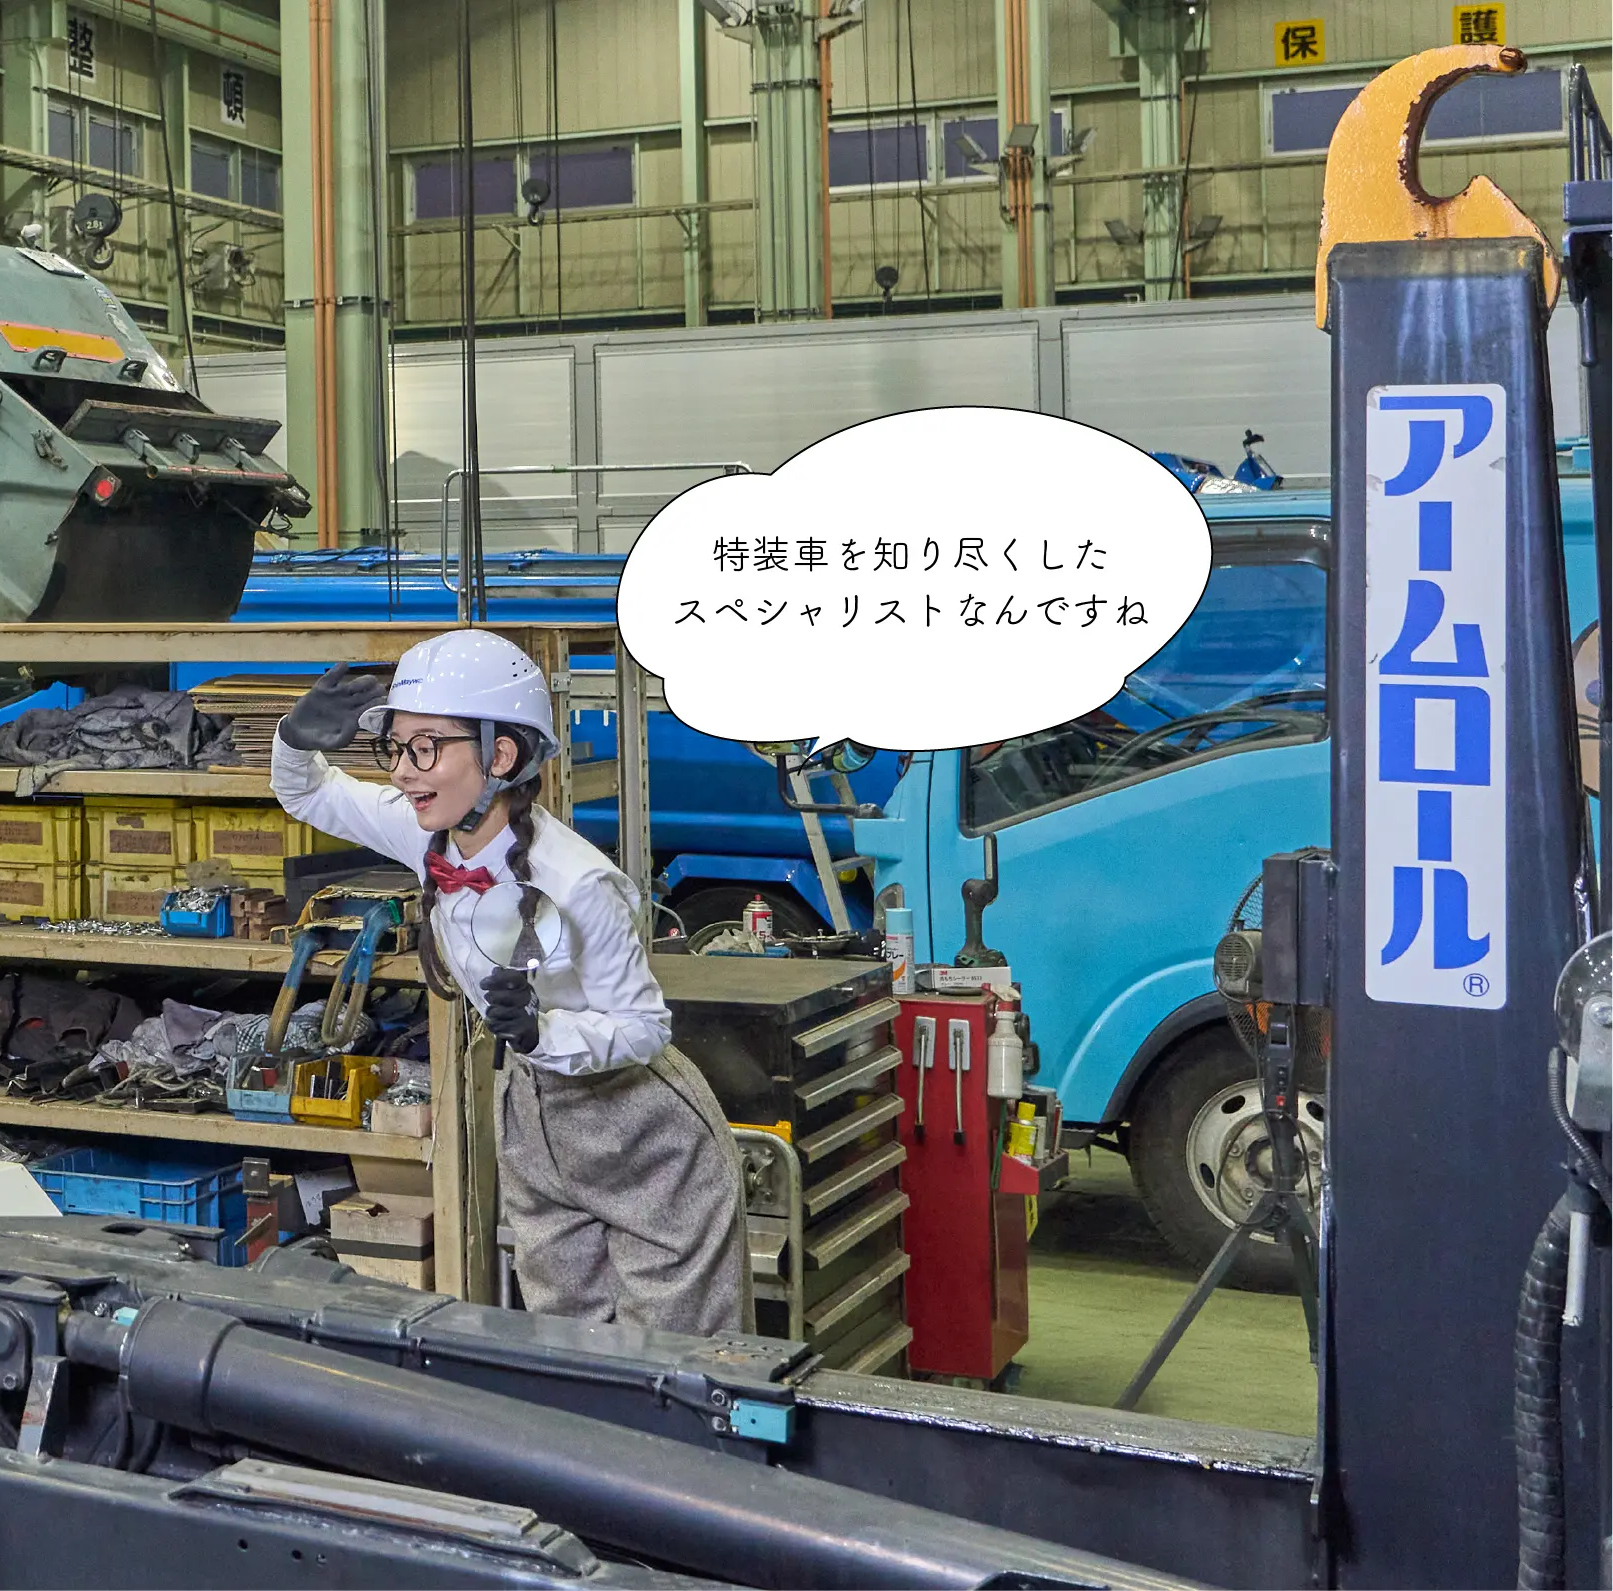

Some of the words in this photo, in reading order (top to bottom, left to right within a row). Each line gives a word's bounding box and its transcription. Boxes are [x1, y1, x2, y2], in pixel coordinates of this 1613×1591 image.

[68, 17, 94, 79] 整
[1281, 25, 1318, 60] 保
[1460, 9, 1498, 44] 護
[223, 69, 245, 124] 頓
[1379, 395, 1494, 970] アームロール
